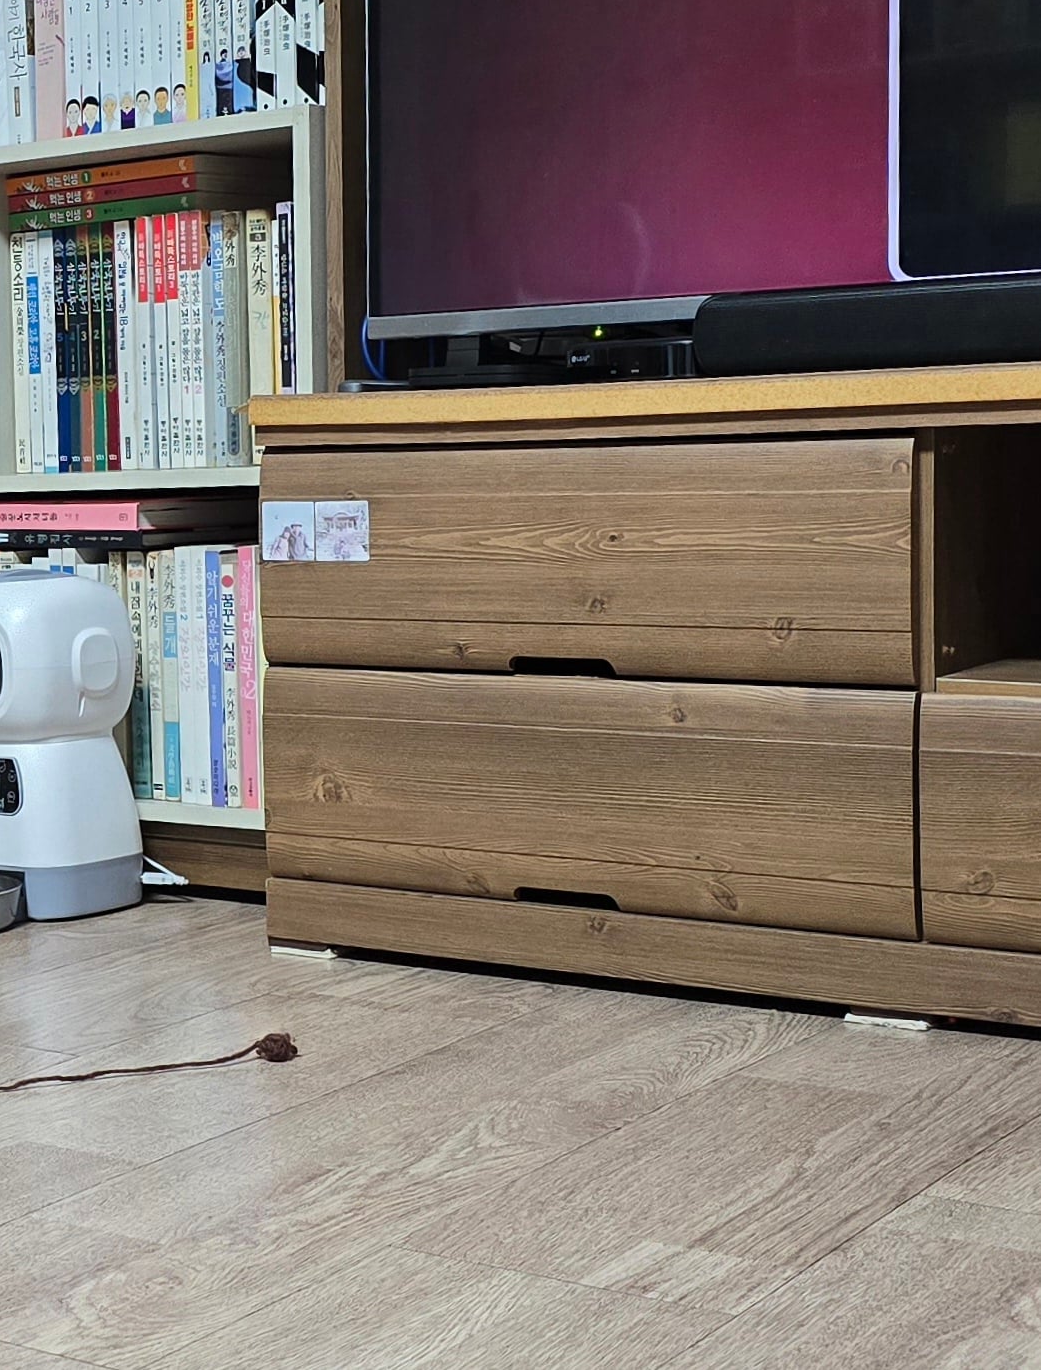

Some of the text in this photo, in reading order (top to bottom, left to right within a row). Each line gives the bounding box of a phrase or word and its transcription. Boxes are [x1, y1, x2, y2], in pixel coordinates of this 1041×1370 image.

[8, 23, 28, 80] 한국사
[11, 236, 25, 302] 천둥소리
[251, 246, 268, 295] 李外秀
[163, 563, 176, 656] 李外秀 들개
[221, 593, 235, 636] 꿈꾸는
[241, 610, 255, 678] 대한민국
